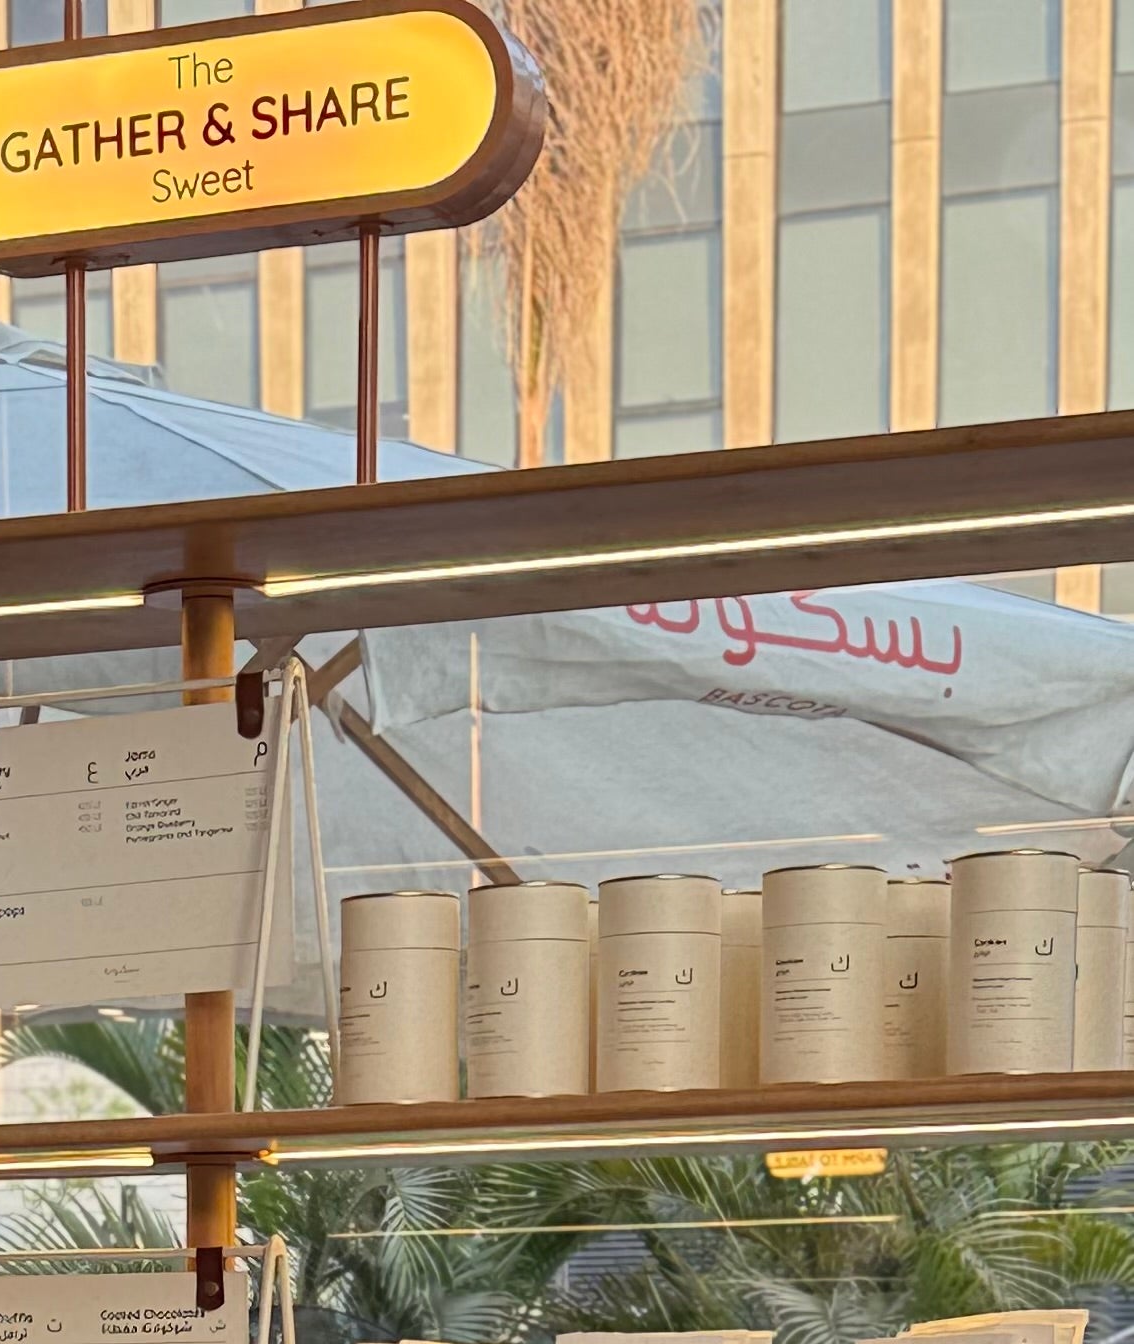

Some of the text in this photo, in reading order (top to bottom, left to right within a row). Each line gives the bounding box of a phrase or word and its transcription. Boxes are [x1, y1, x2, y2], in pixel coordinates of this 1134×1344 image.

[167, 53, 234, 91] The
[0, 76, 411, 175] GATHER & SHARE
[151, 160, 255, 204] Sweet
[699, 687, 849, 718] BASCOTA
